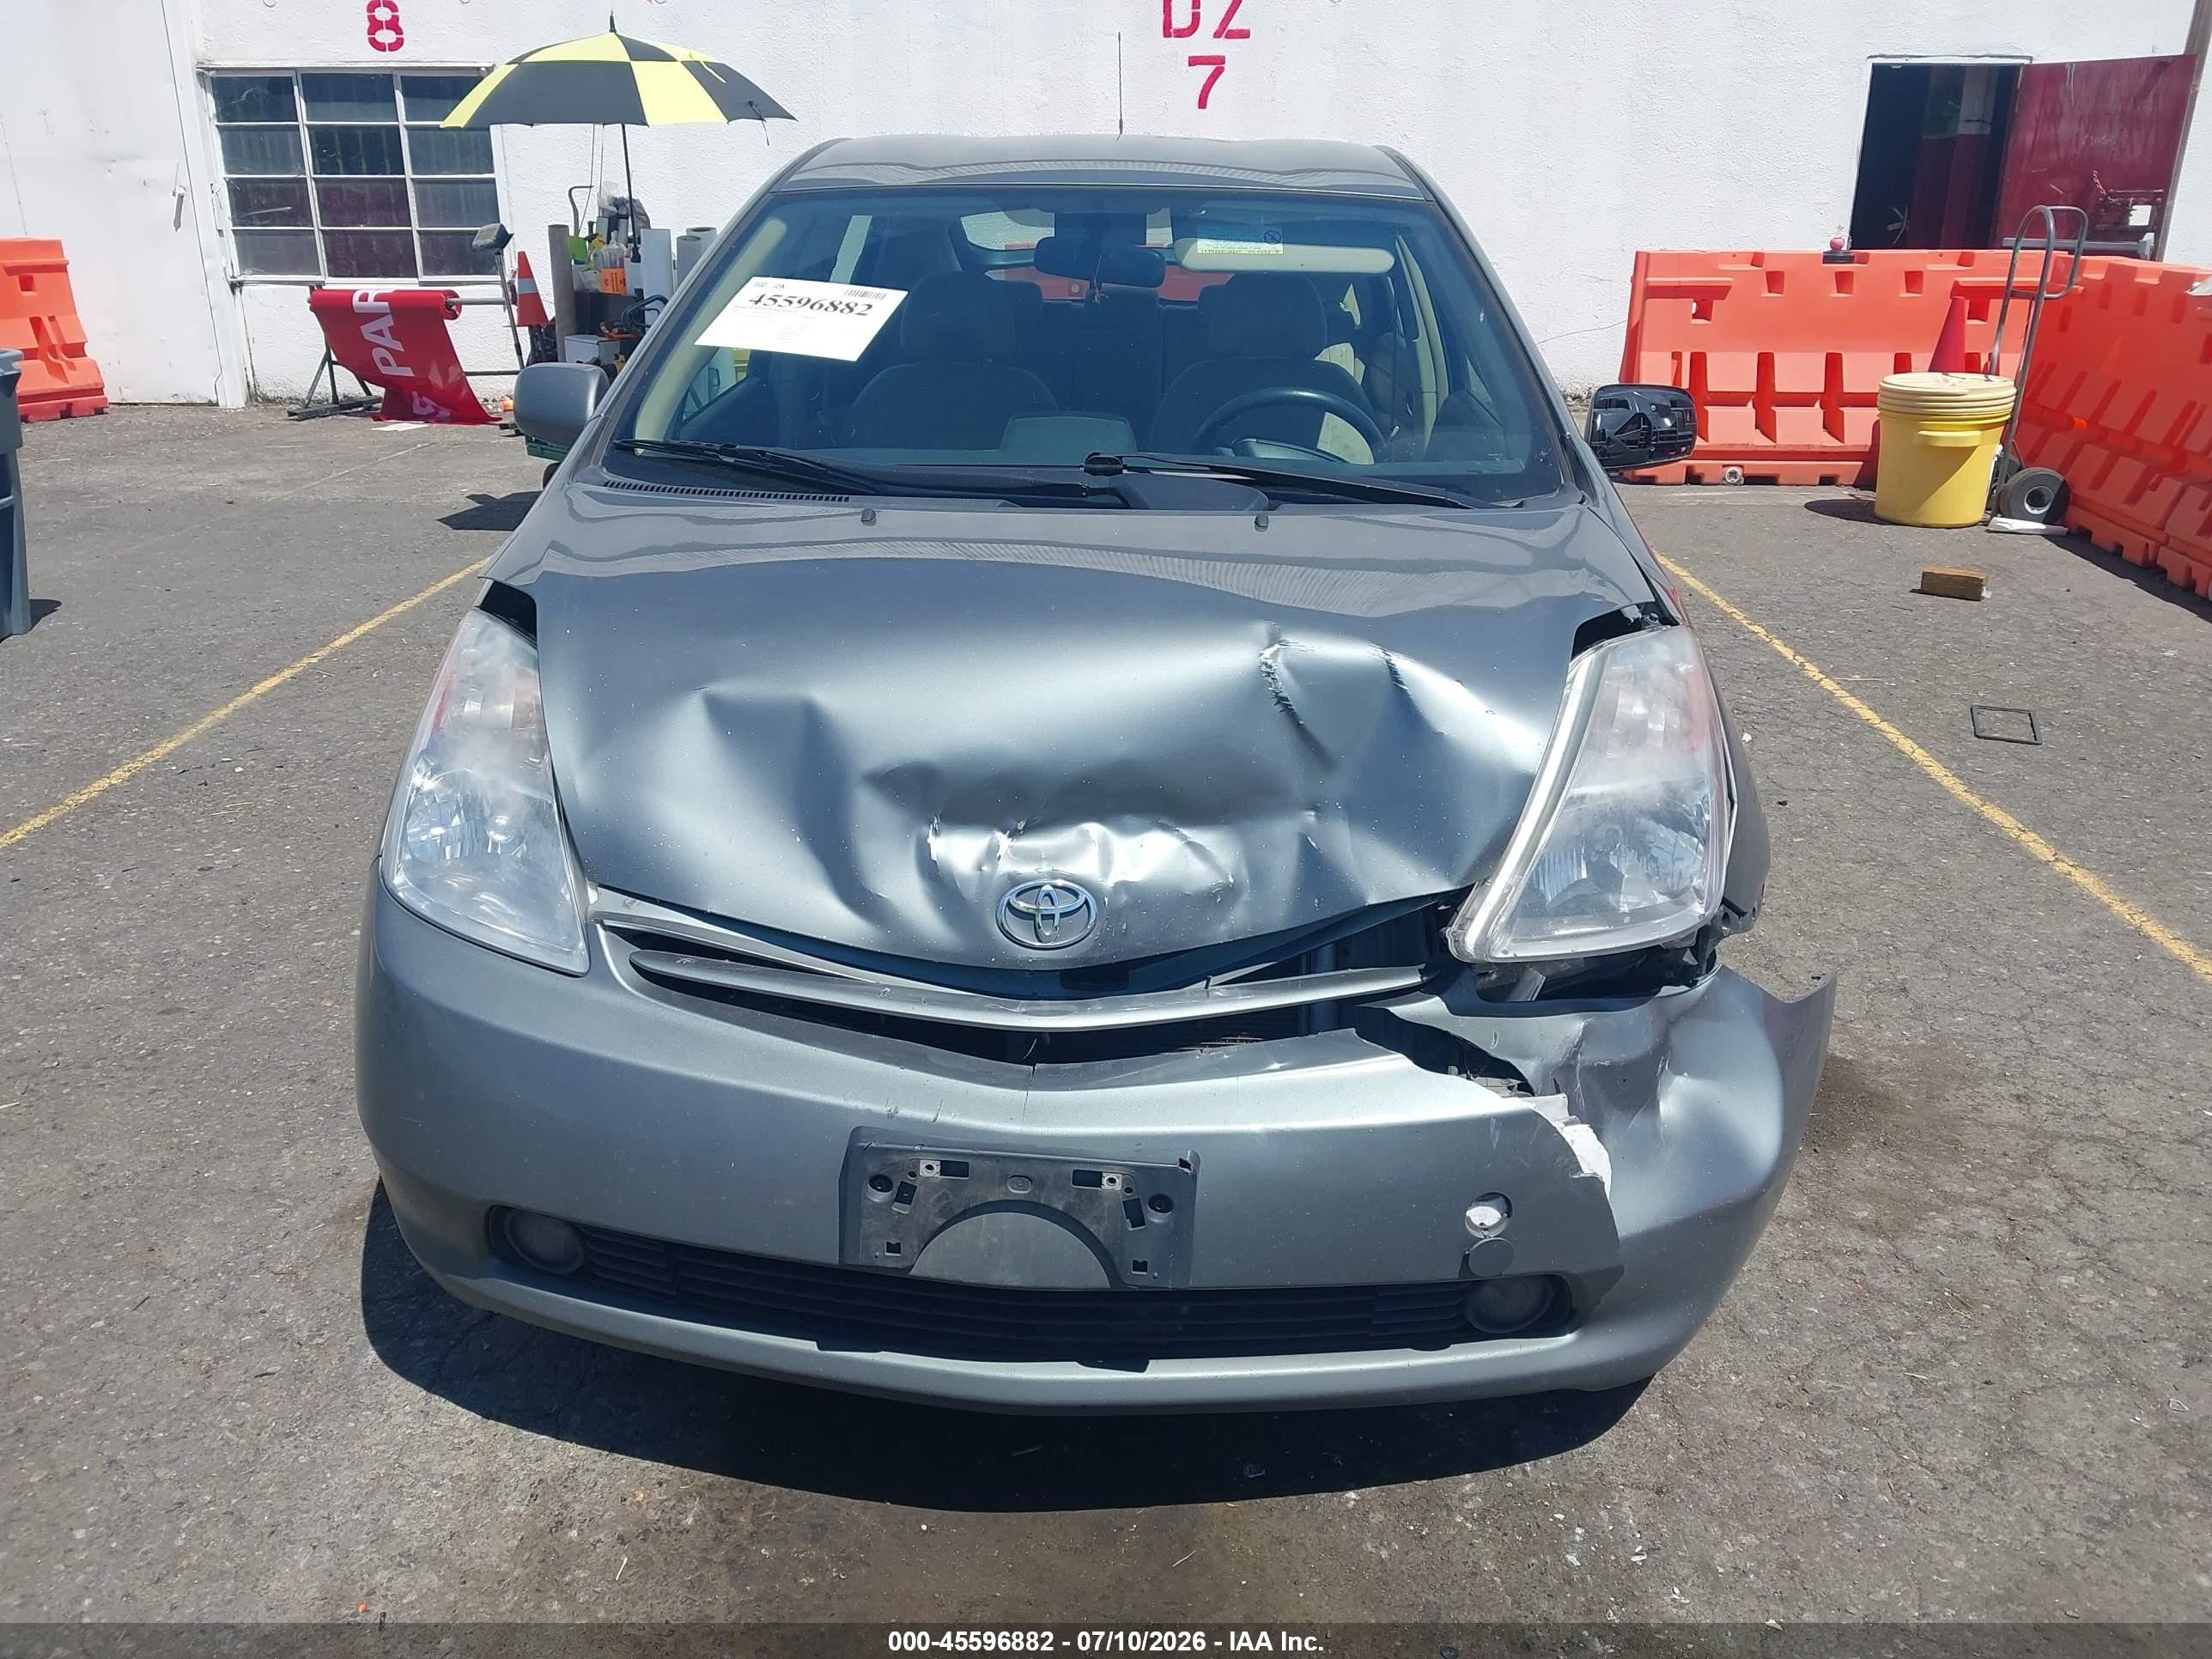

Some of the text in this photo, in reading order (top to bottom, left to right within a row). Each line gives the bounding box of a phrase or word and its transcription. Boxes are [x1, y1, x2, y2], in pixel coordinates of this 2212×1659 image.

[367, 0, 404, 52] 8
[1188, 55, 1226, 109] 7
[748, 293, 873, 316] 45596882
